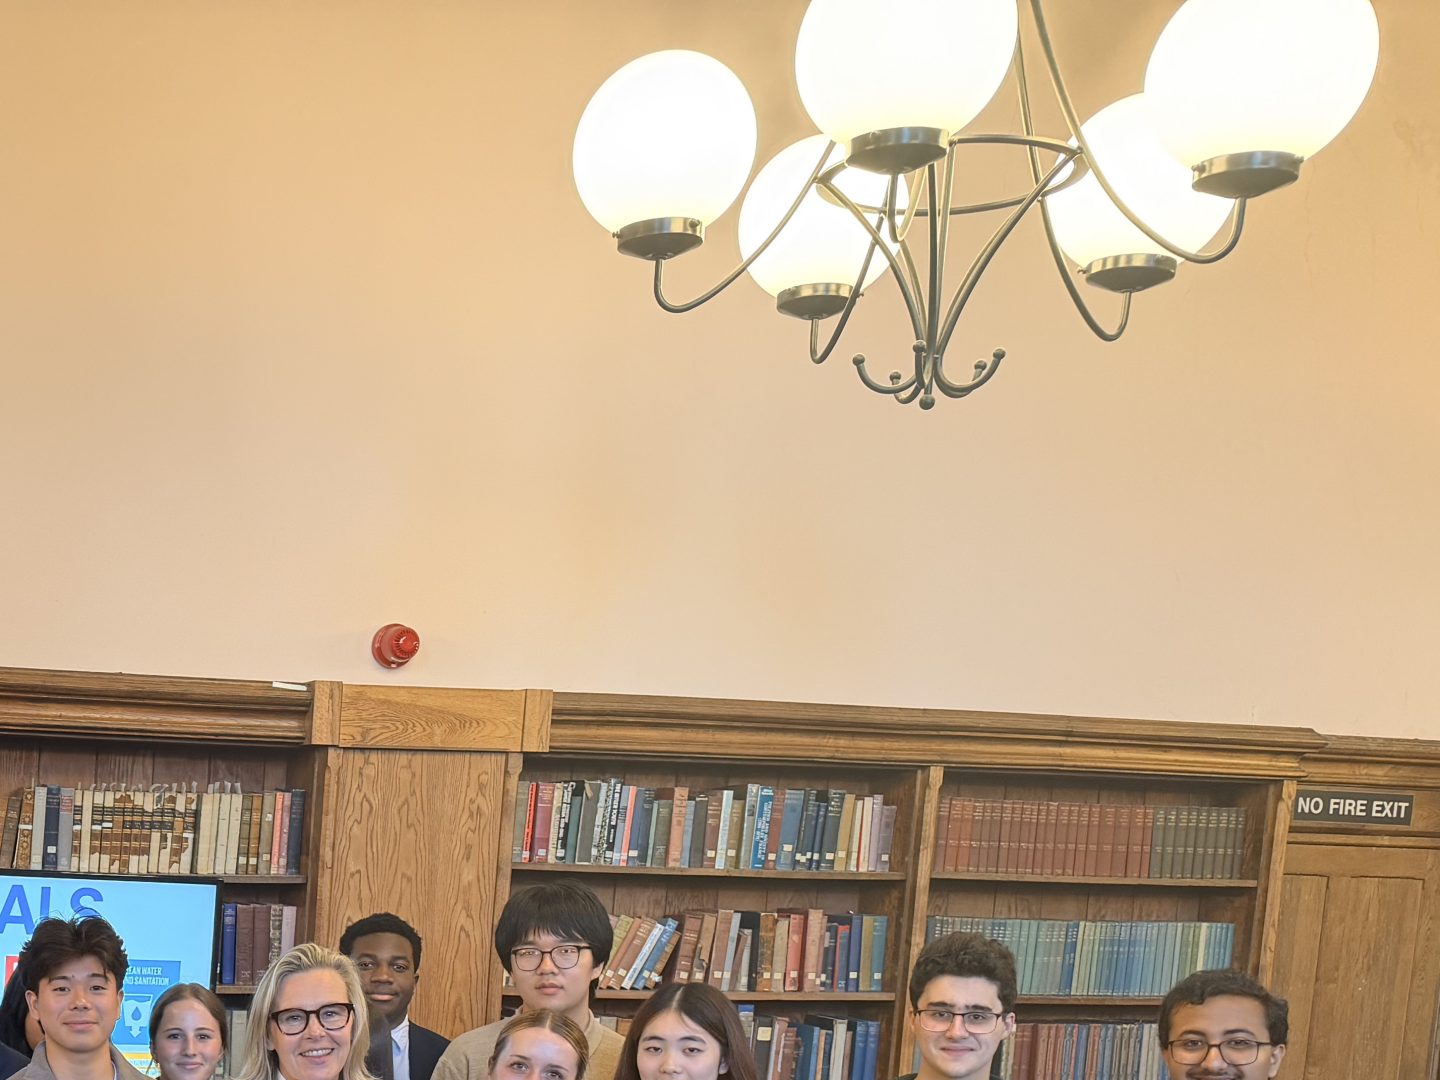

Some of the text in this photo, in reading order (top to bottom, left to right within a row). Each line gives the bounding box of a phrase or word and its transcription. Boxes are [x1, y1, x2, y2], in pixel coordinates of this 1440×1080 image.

[1297, 796, 1409, 818] NO FIRE EXIT
[142, 966, 162, 975] WATER
[134, 976, 169, 986] SANITATION
